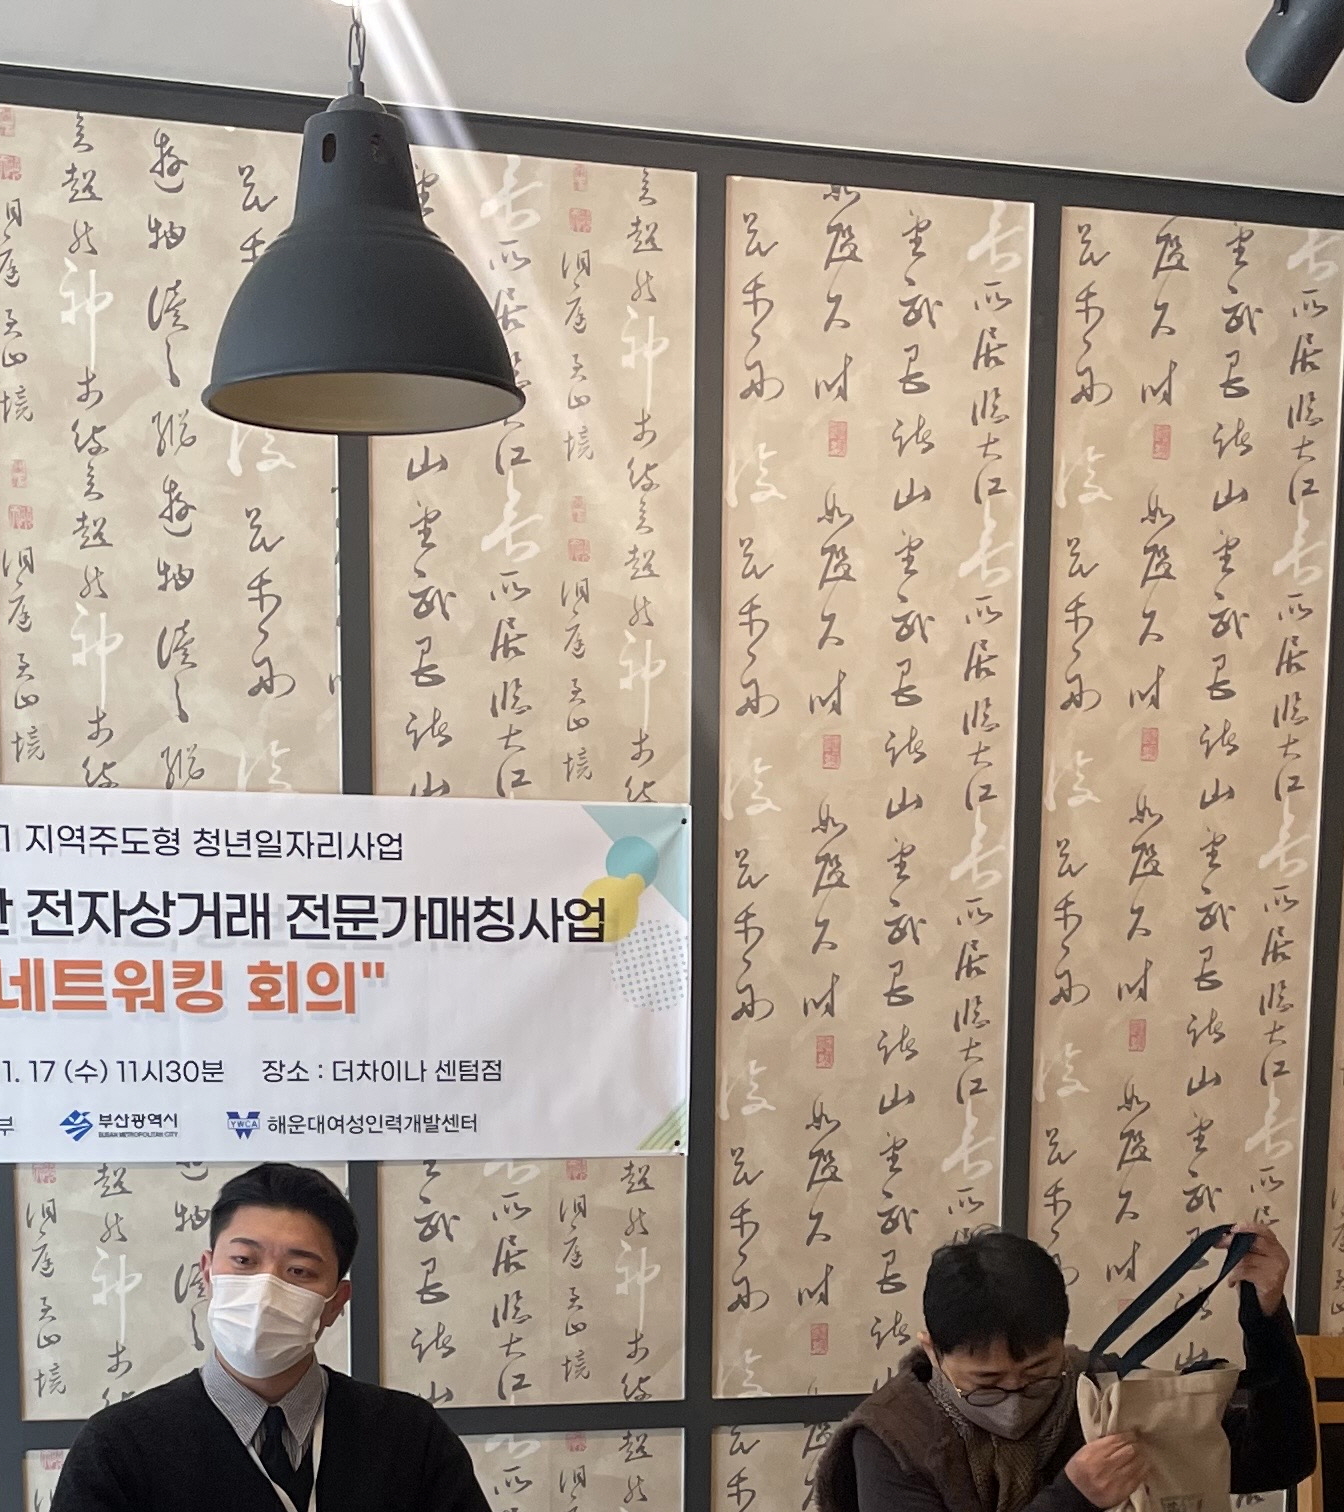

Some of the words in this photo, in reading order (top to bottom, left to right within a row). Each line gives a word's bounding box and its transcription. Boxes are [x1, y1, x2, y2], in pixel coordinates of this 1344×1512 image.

[25, 824, 182, 858] 지역주도형
[193, 828, 403, 861] 청년일자리사업
[26, 888, 272, 940] 전자상거래
[285, 894, 606, 944] 전문가매칭사업
[246, 960, 386, 1014] 회의"
[28, 1060, 56, 1083] 17
[64, 1059, 107, 1084] (수)
[119, 1060, 225, 1083] 11시30분
[262, 1060, 311, 1082] 장소
[333, 1059, 426, 1083] 더차이나
[435, 1060, 503, 1083] 센텀점
[99, 1112, 178, 1129] 부산광역시
[267, 1113, 478, 1134] 해운대여성인력개발센터
